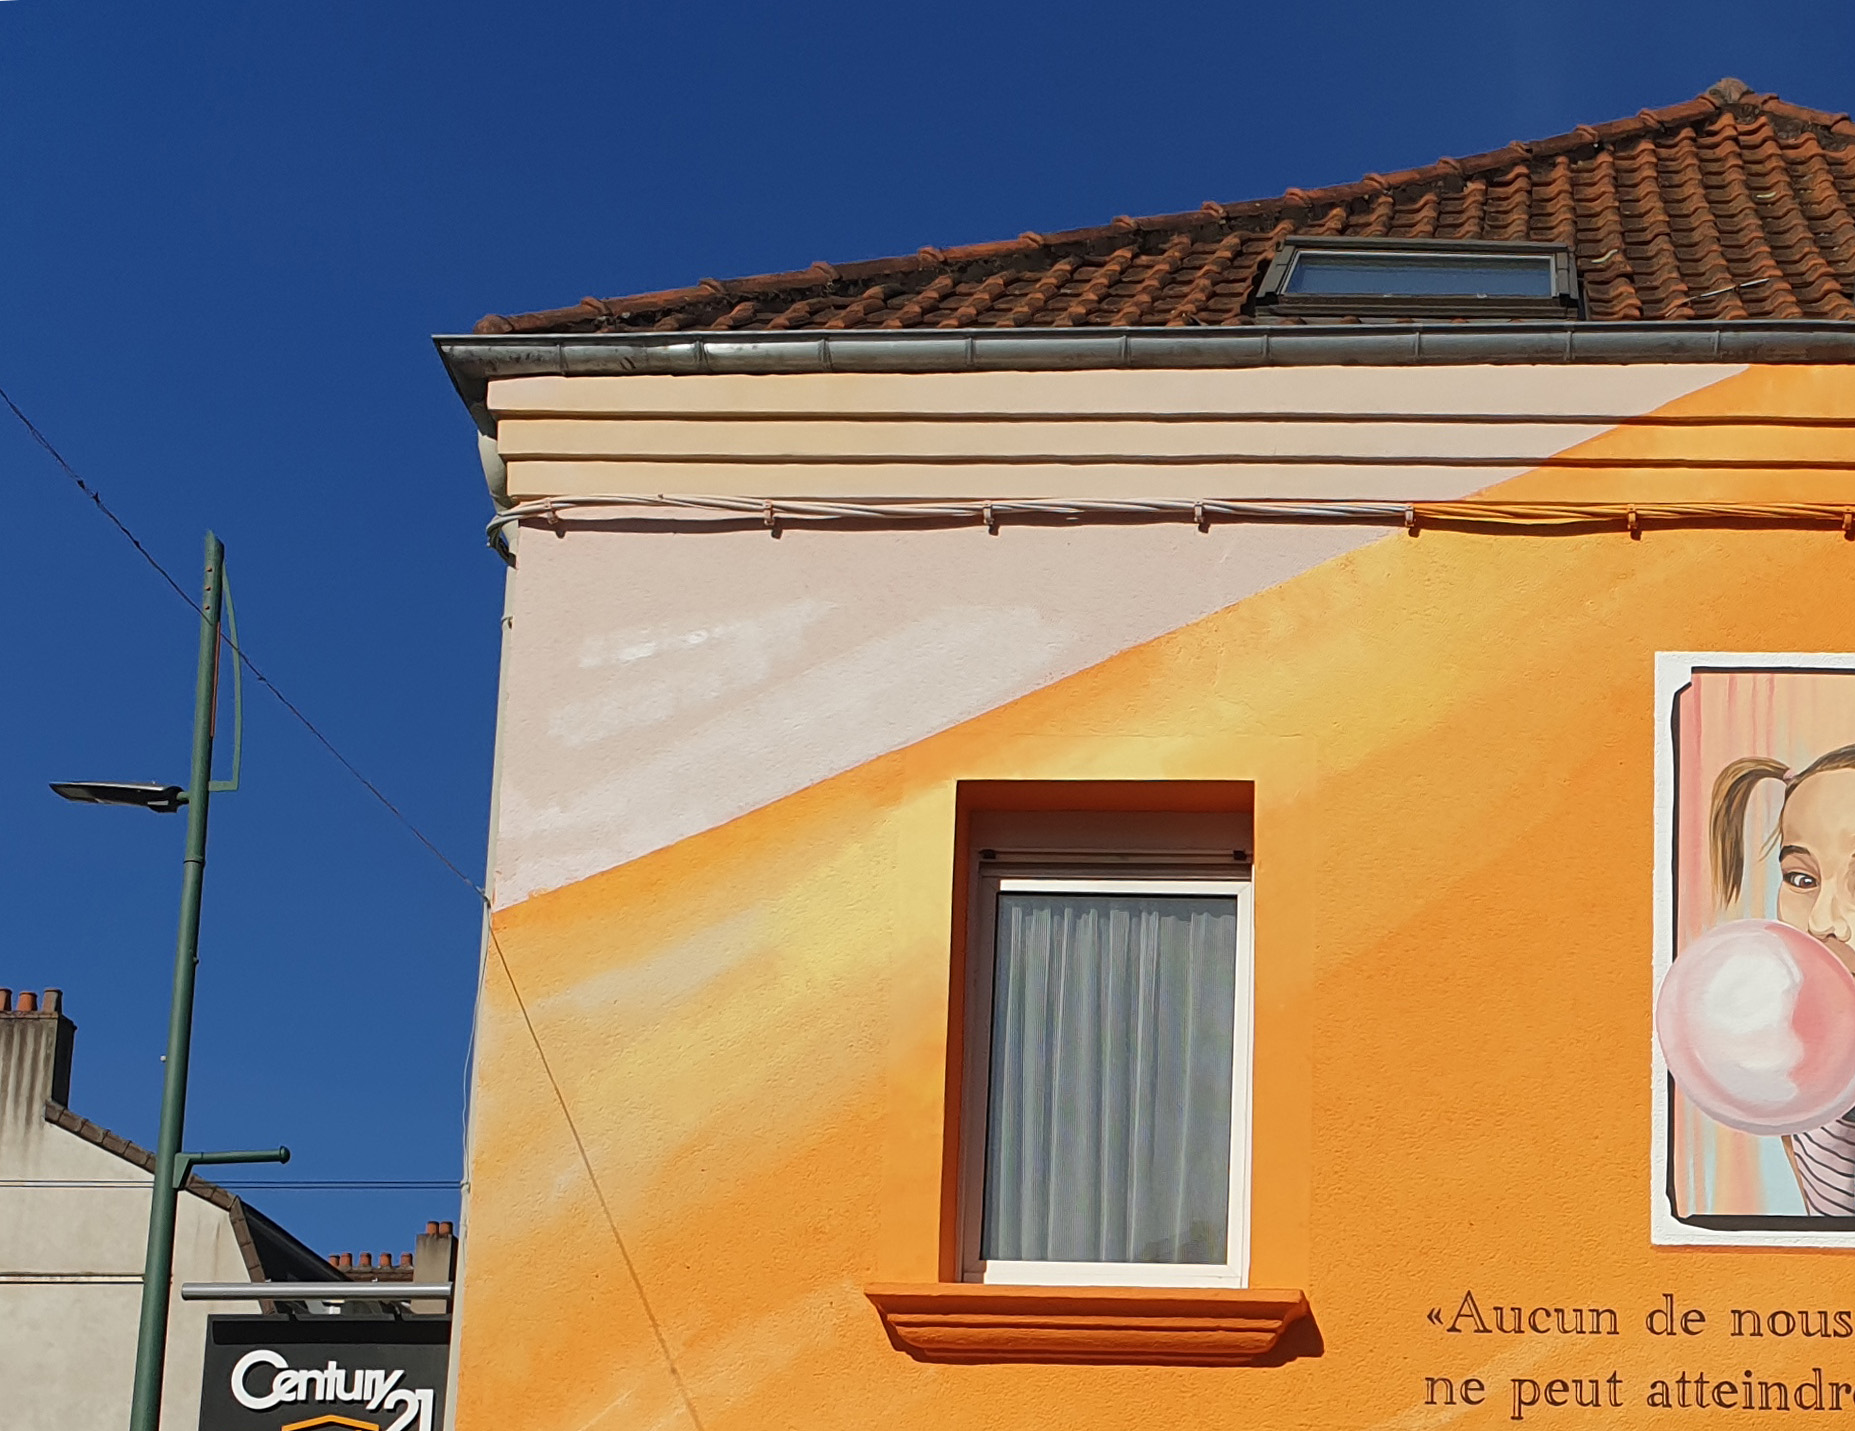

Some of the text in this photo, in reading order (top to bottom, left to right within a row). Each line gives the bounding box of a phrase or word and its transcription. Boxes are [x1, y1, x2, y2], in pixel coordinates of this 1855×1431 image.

[1426, 1290, 1619, 1336] «Aucun
[1645, 1293, 1706, 1336] de
[231, 1349, 405, 1410] Century
[1424, 1375, 1485, 1406] ne
[1510, 1370, 1623, 1420] peut
